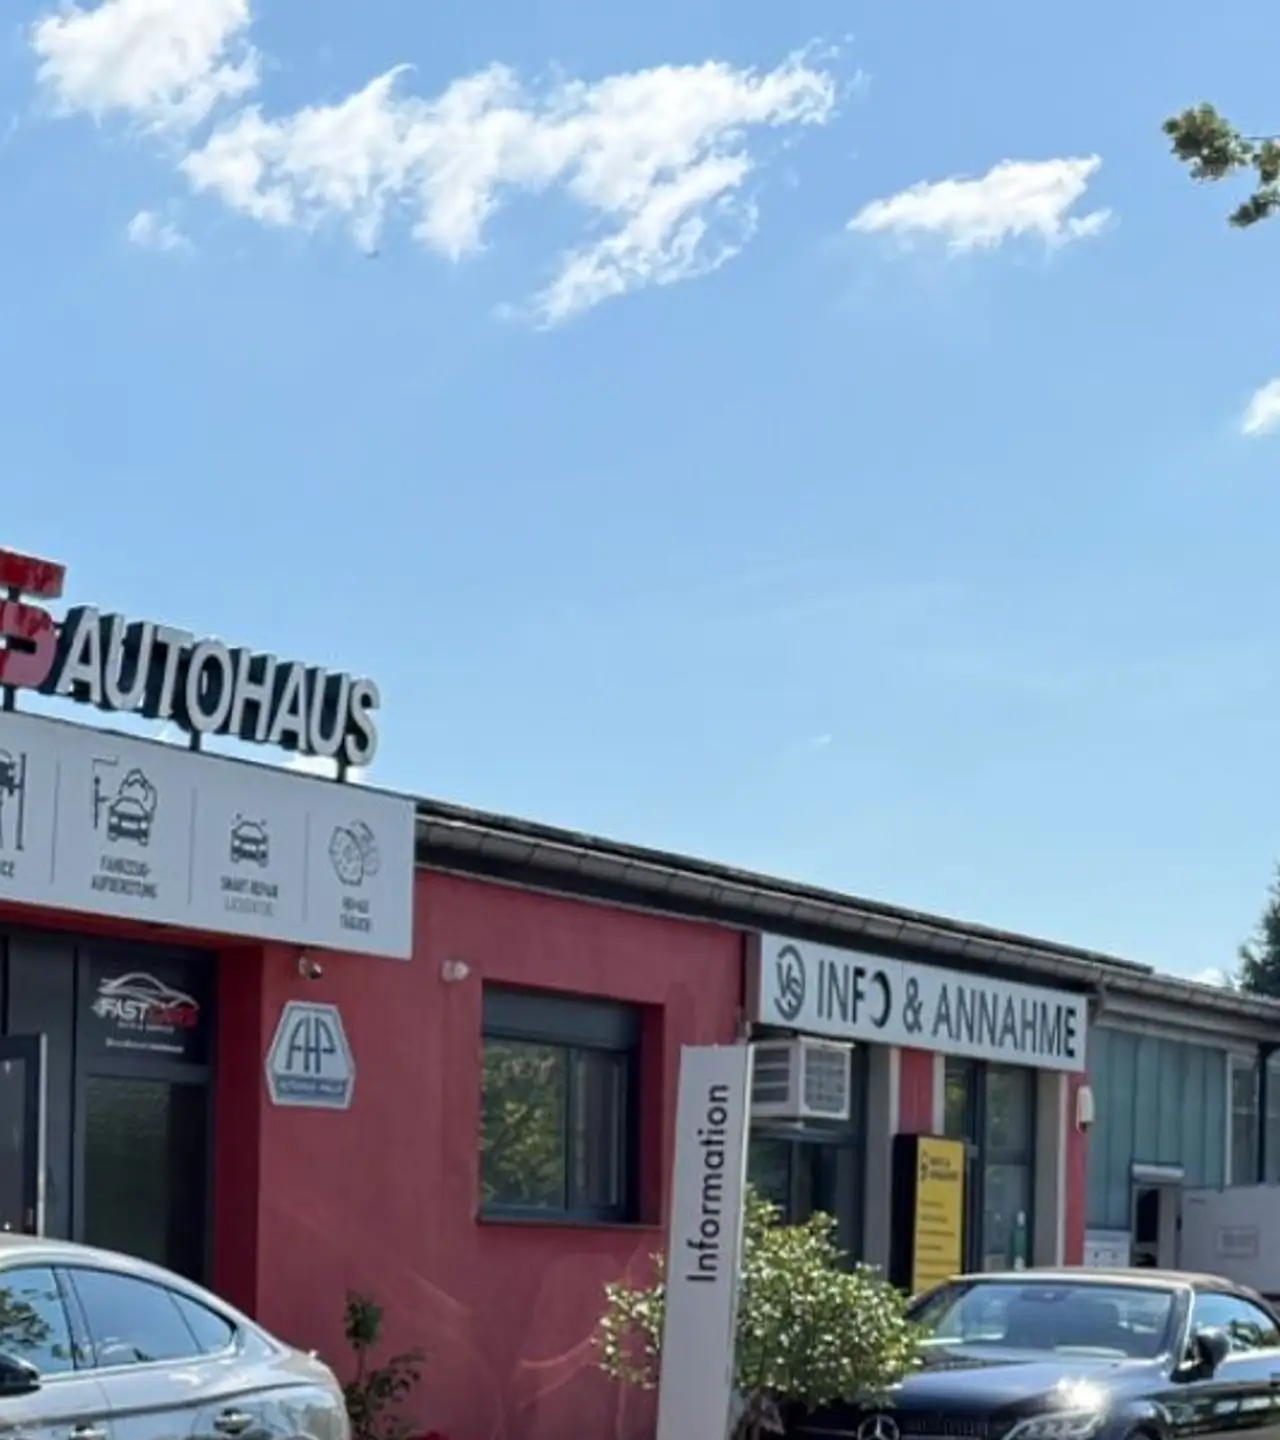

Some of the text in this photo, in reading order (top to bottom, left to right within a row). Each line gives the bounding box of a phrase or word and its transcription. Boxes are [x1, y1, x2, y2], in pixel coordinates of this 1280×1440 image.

[54, 606, 381, 767] AUTOHAUS
[902, 976, 924, 1034] &
[932, 983, 1078, 1059] ANNAHME
[685, 1083, 731, 1283] Information
